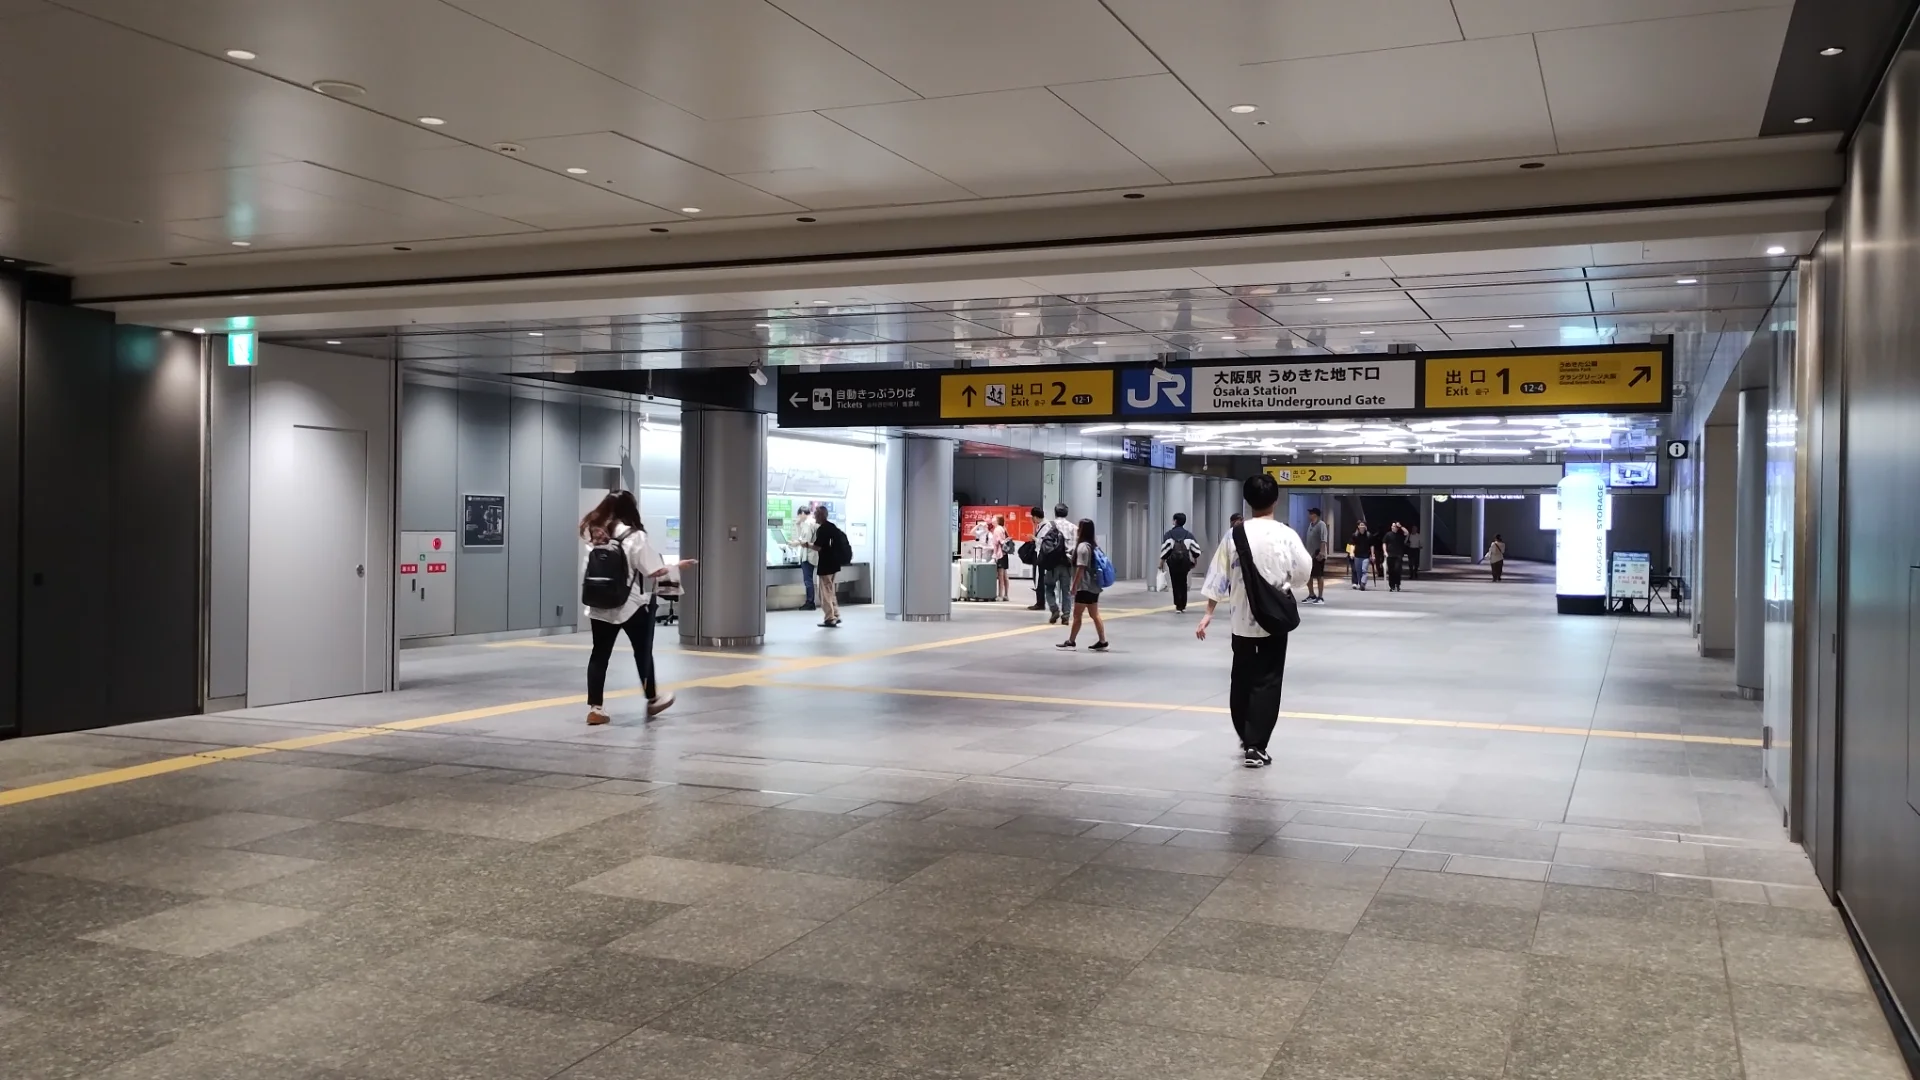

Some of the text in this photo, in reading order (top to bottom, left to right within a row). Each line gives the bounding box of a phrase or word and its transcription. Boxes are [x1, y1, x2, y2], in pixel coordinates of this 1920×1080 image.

[1214, 367, 1380, 384] 大阪駅 うめきた地下口
[1446, 368, 1544, 394] 出口 1 12-4
[836, 388, 916, 400] 自動きっぷうりば
[1012, 383, 1042, 396] 出口
[1051, 381, 1066, 405] 2
[1127, 374, 1186, 408] JR
[1253, 385, 1297, 396] Station
[1446, 386, 1469, 396] Exit
[837, 401, 862, 409] Tickets
[1011, 397, 1029, 407] Exit
[1213, 394, 1386, 409] Umekita Underground Gate
[1308, 469, 1317, 481] 2
[1596, 485, 1604, 530] STORAGE
